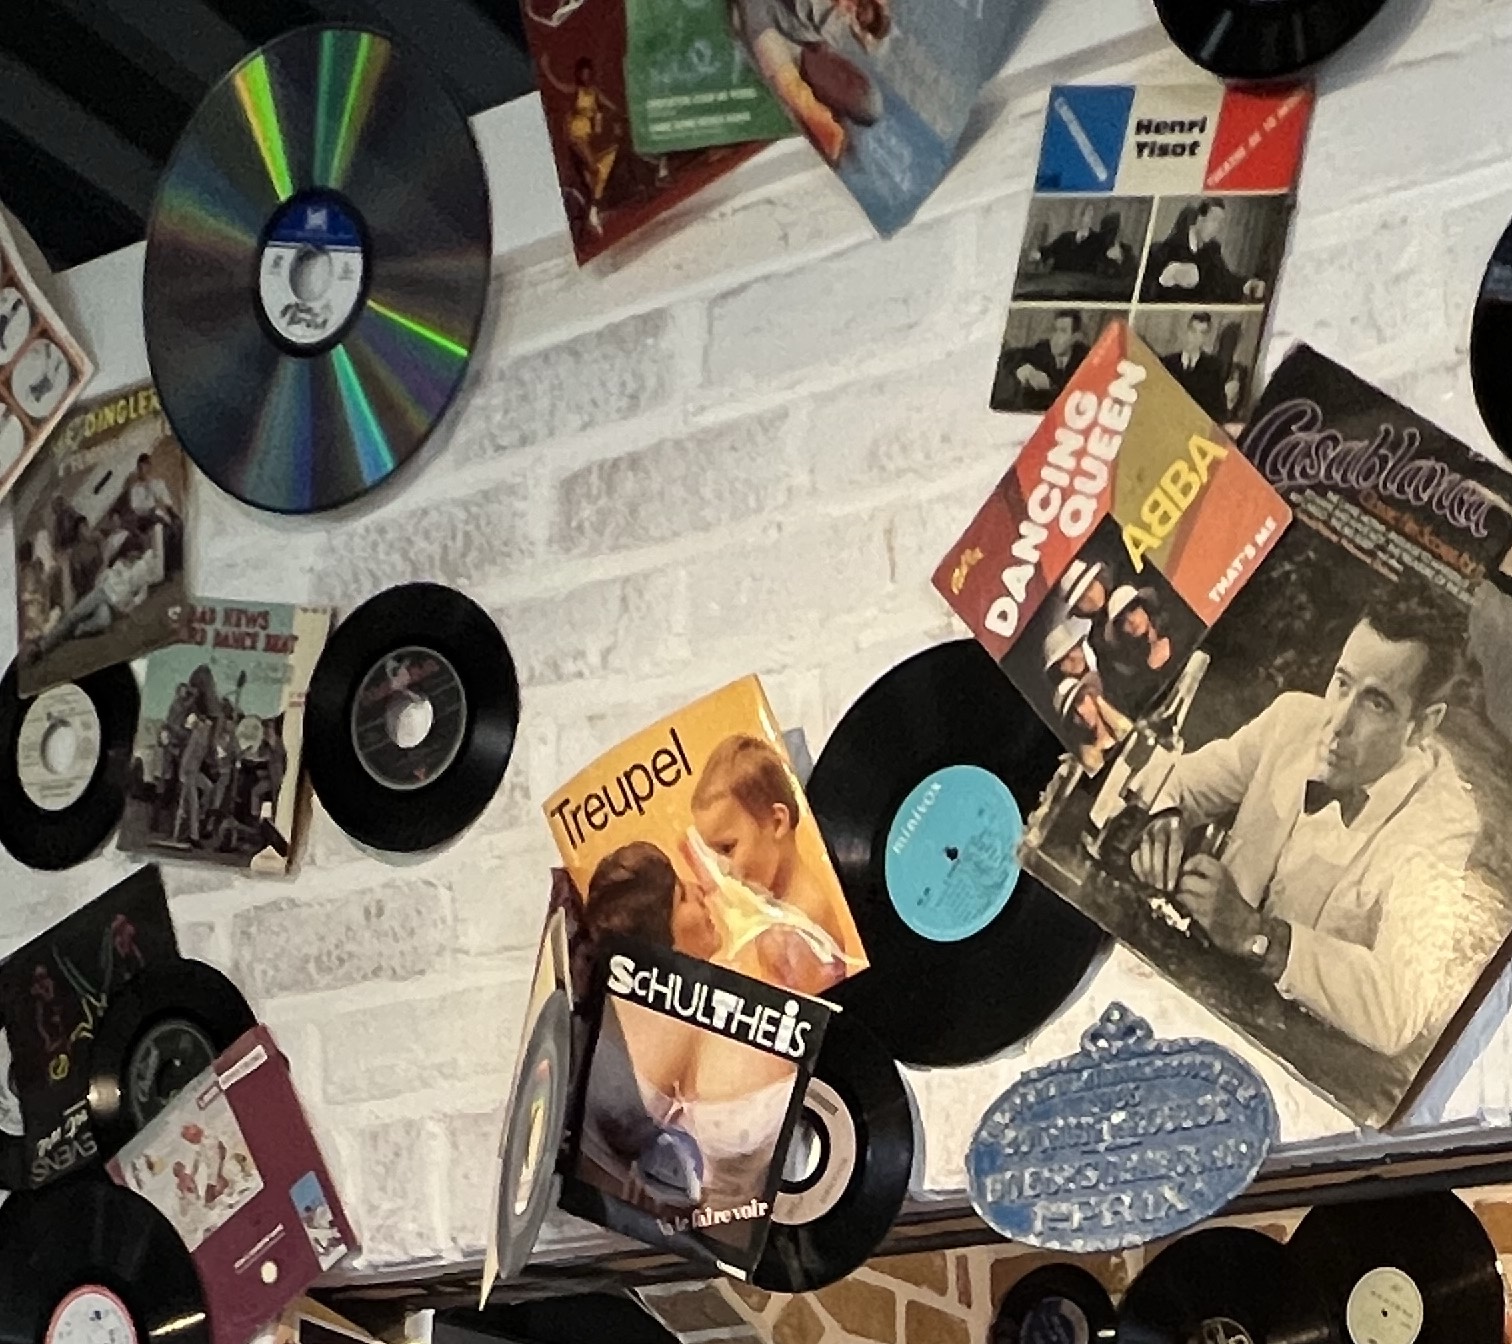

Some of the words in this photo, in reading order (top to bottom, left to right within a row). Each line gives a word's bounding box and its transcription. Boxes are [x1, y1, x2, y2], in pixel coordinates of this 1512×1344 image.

[1135, 116, 1208, 135] Henri
[1135, 140, 1201, 159] Tisot
[1058, 359, 1147, 538] QUEEN
[984, 389, 1099, 638] DANCING
[1121, 433, 1230, 574] ABBA
[1208, 544, 1256, 602] THAT'S
[1254, 516, 1277, 548] ME
[551, 727, 694, 850] Treupel
[893, 782, 942, 854] minivox
